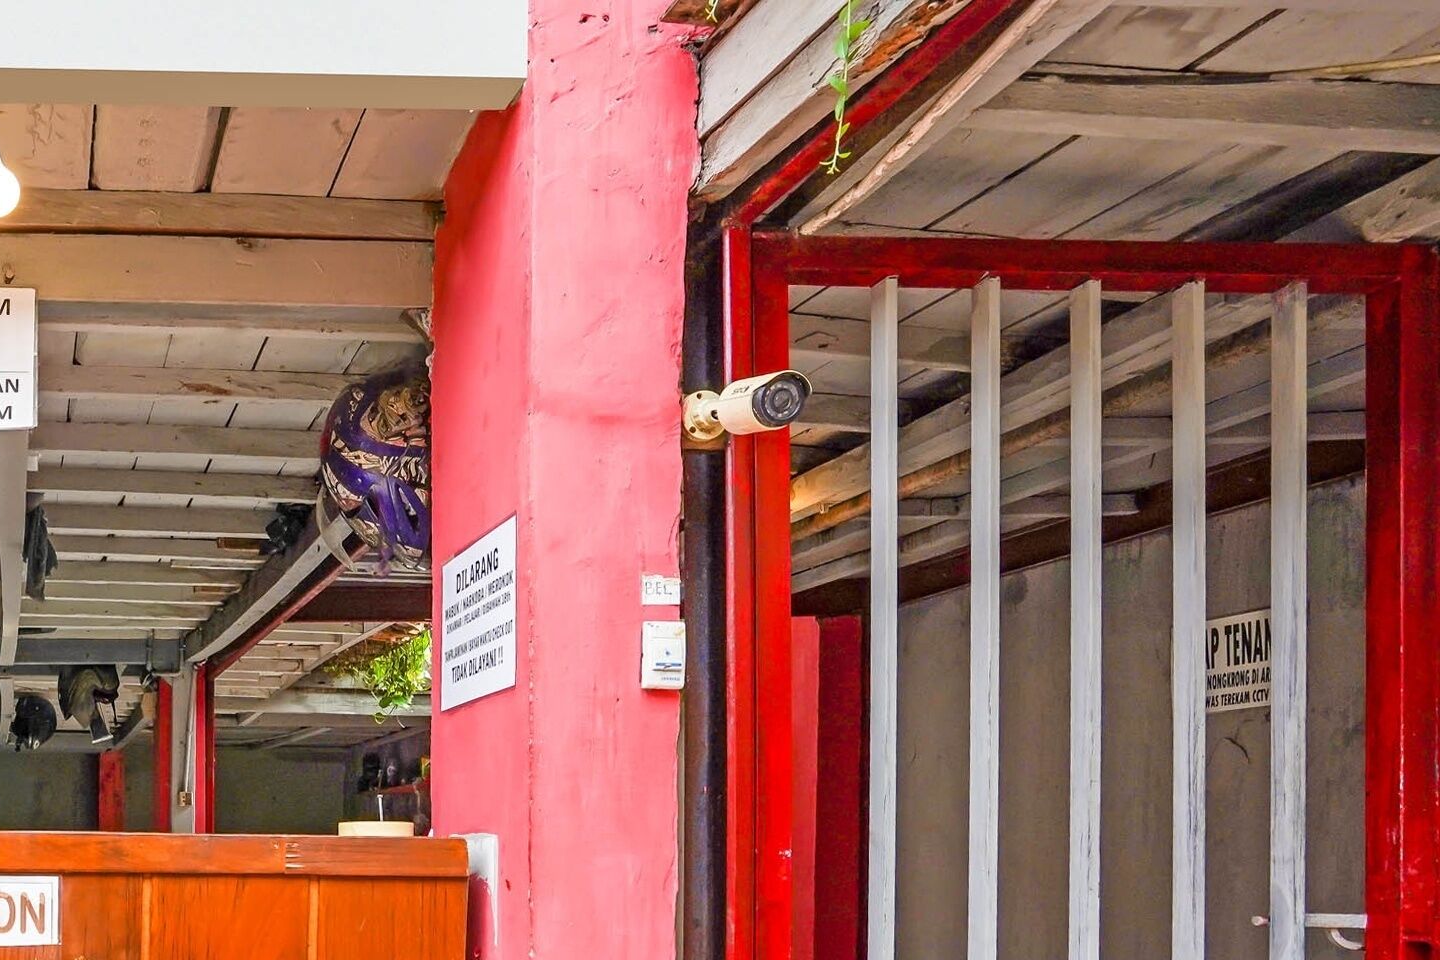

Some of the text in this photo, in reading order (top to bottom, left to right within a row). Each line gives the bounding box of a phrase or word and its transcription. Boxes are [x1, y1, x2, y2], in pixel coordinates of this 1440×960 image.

[456, 547, 499, 594] DILARANG
[488, 570, 514, 596] MEROKOK
[505, 619, 513, 635] OUT
[452, 660, 468, 684] TIDAK
[469, 648, 496, 677] DILAYANI
[1252, 669, 1259, 685] DI
[1221, 691, 1250, 706] TEREKAM
[1252, 689, 1269, 703] CCTV
